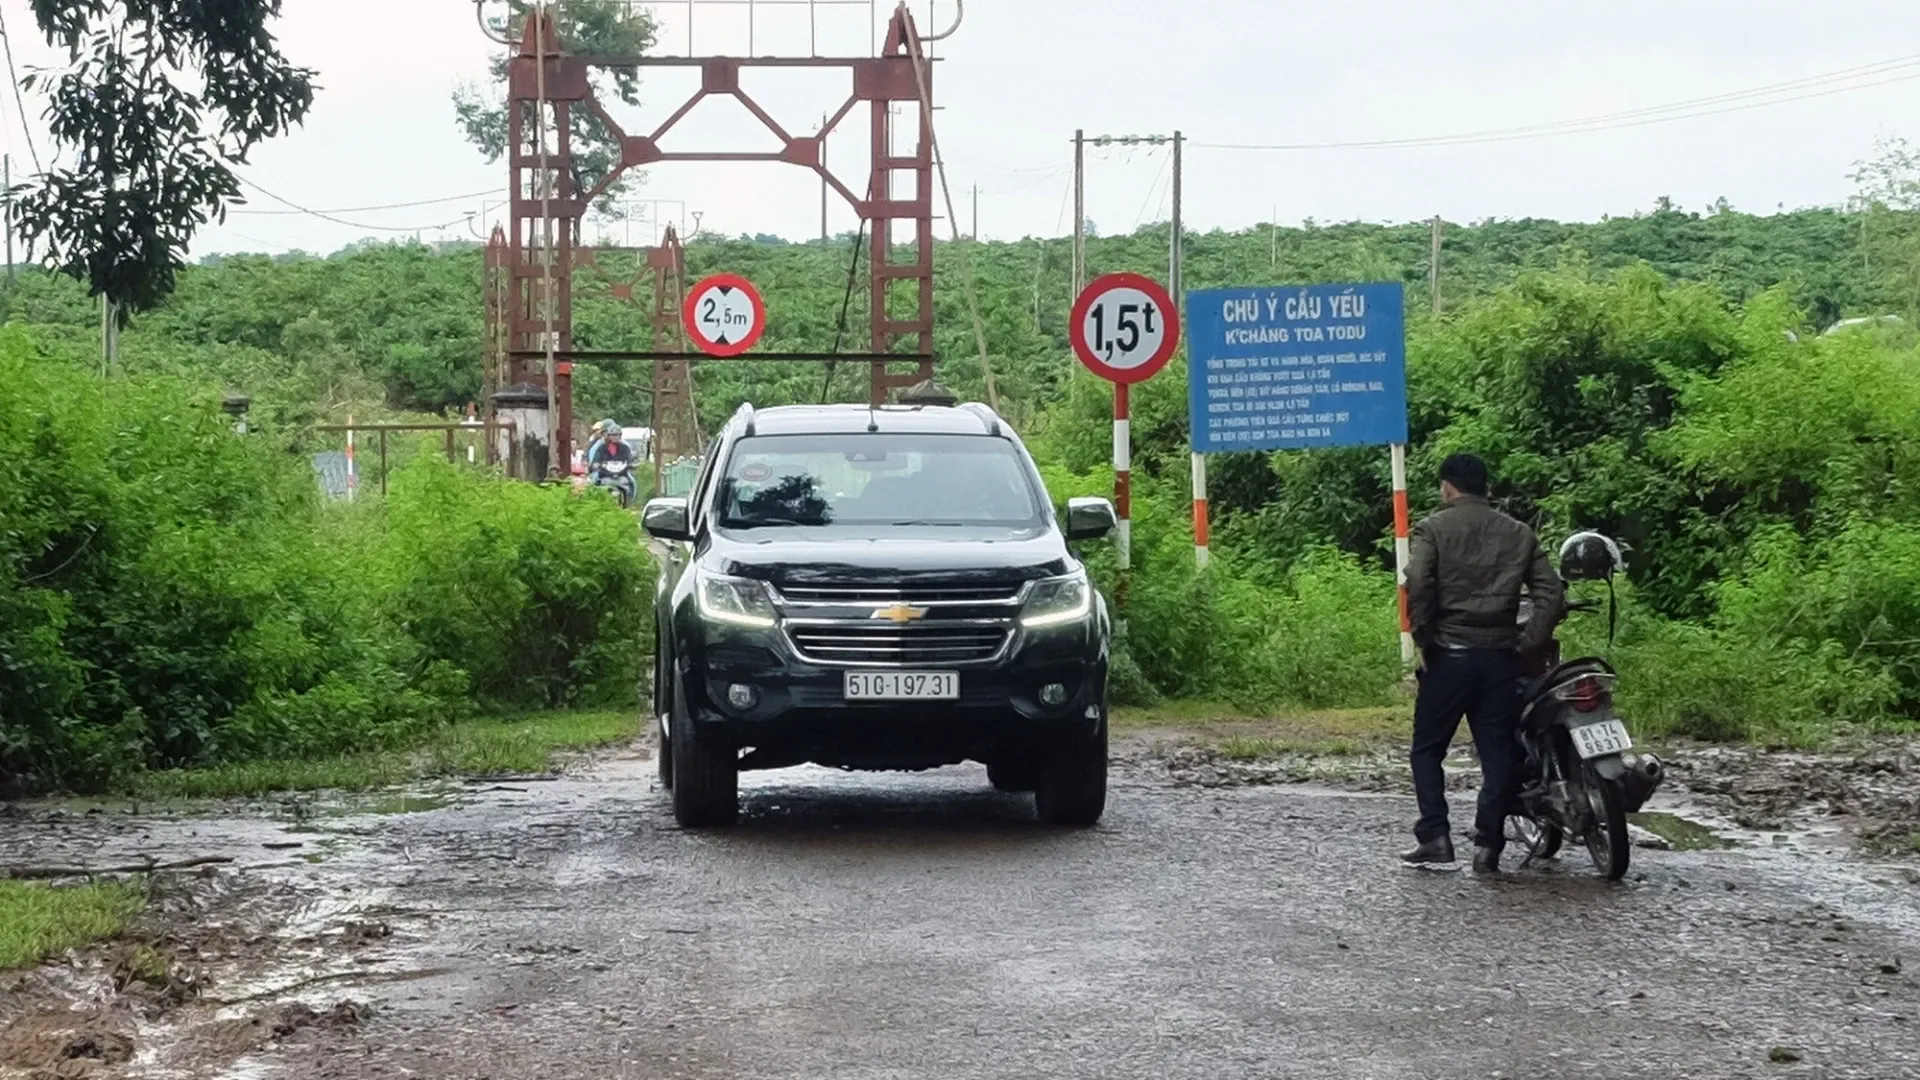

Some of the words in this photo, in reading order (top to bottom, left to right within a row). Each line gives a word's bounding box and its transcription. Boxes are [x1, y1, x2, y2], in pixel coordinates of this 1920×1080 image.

[1223, 293, 1259, 323] CHÚ
[1266, 292, 1278, 321] Ý
[1329, 288, 1365, 318] YẾU
[1091, 302, 1155, 361] 1,5t
